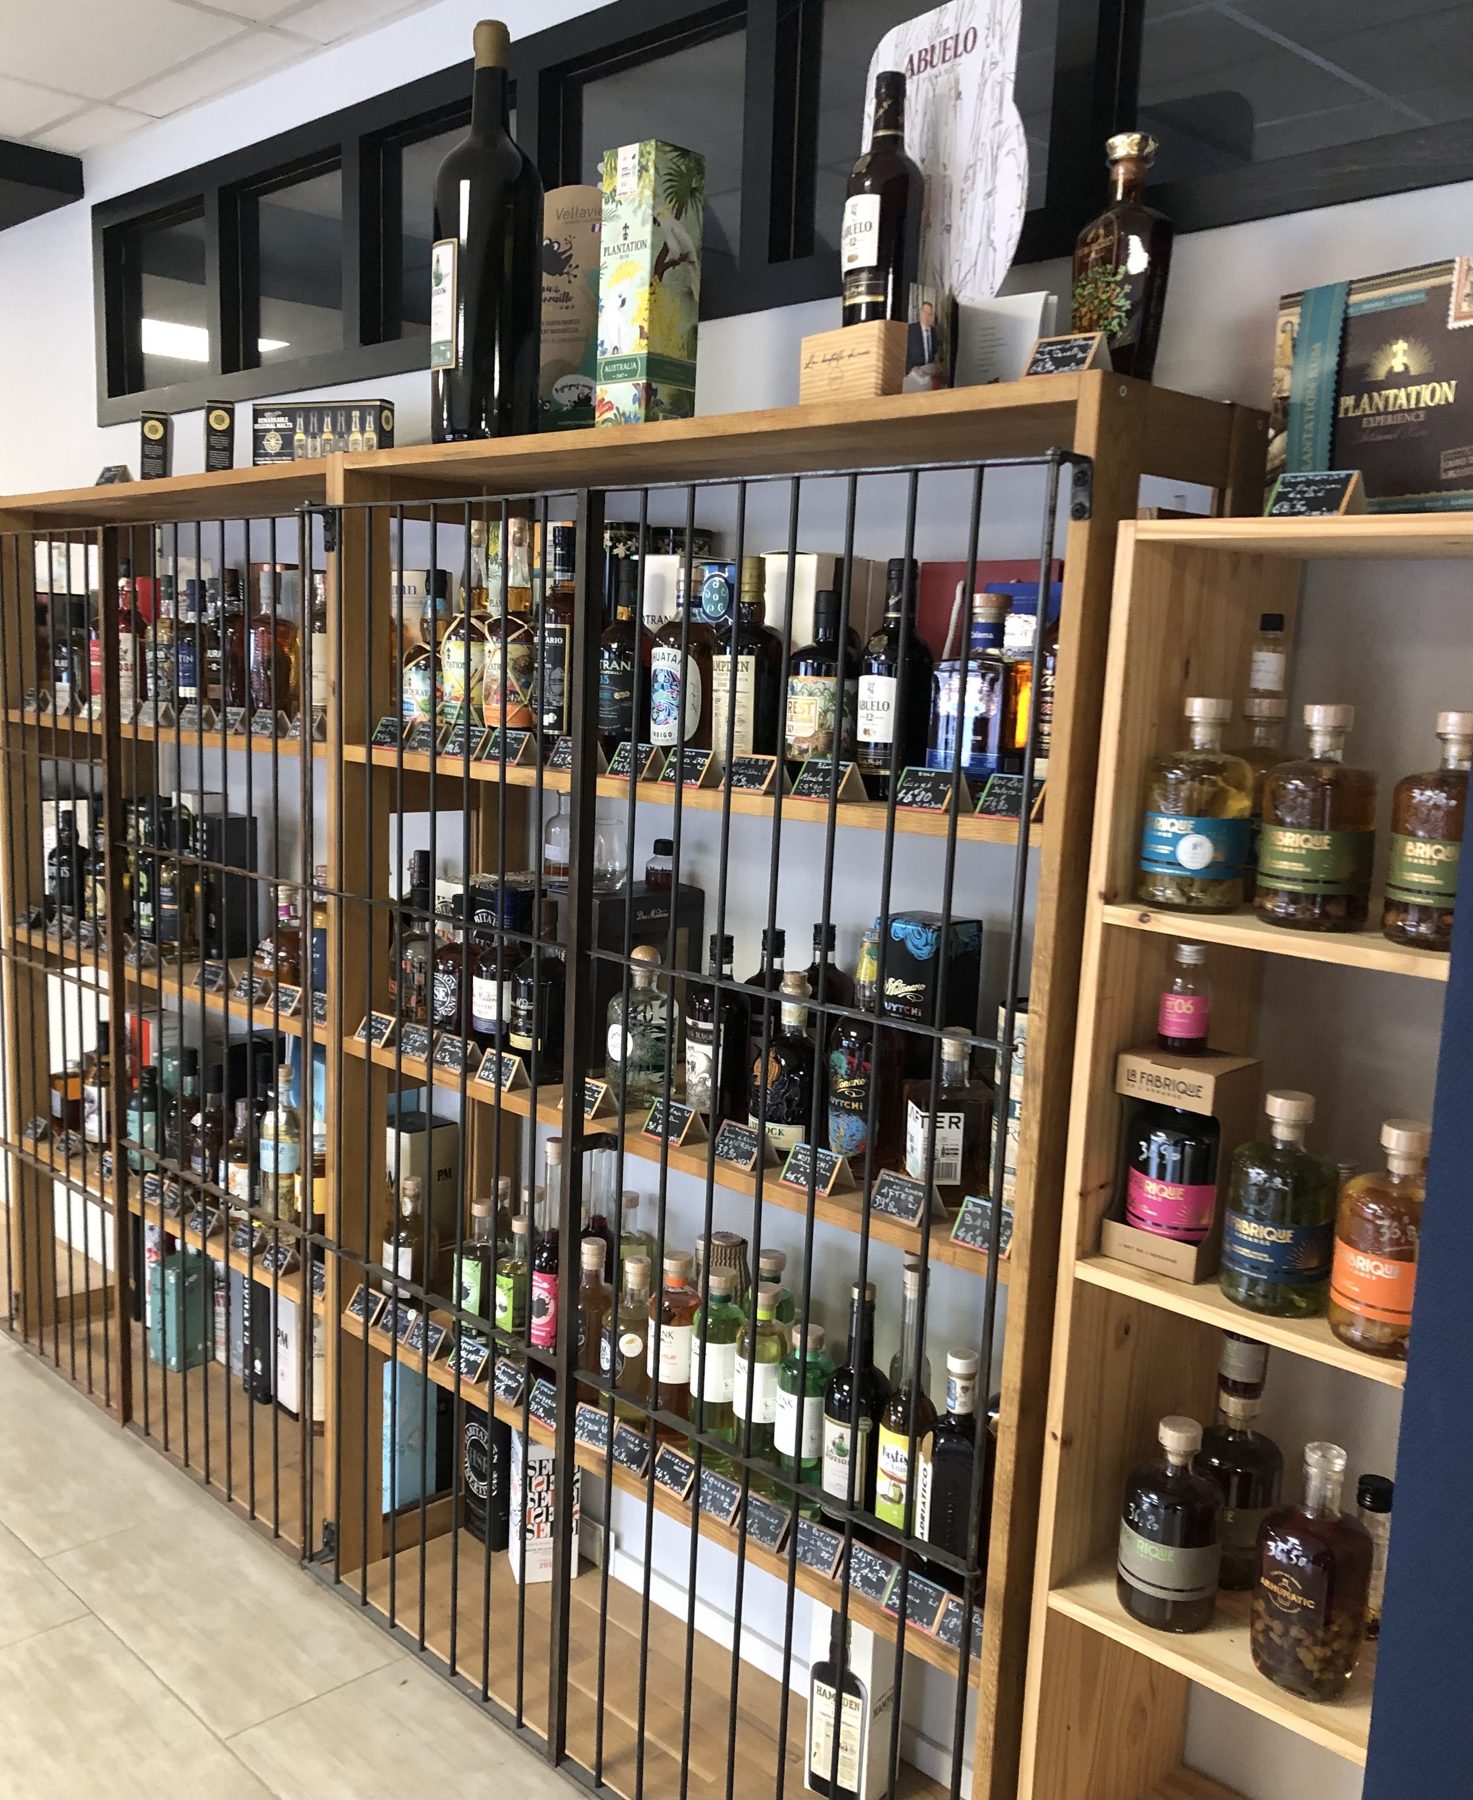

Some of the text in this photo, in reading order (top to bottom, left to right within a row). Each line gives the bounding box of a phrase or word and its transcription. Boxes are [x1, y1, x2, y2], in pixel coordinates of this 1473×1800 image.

[905, 26, 978, 78] ABUELO
[603, 239, 648, 257] PLANTATION
[604, 361, 637, 373] AUSTRALIA
[1338, 380, 1458, 418] PLANTATION
[1302, 381, 1320, 471] LANTATION
[1361, 410, 1426, 428] EXPERIENCE
[643, 614, 670, 625] TRAN
[600, 659, 631, 671] TRAN
[652, 652, 682, 666] HUATA
[713, 661, 750, 673] AMPEN
[787, 700, 814, 715] REST
[1153, 816, 1196, 834] RIQUE
[1272, 831, 1333, 851] BRIQUE
[1404, 841, 1459, 861] BRIQU
[433, 988, 448, 1002] SE
[1138, 1071, 1204, 1100] FABRIQUE
[1144, 1179, 1185, 1201] RIQUE
[920, 1466, 929, 1541] ADRIATICO
[1136, 1539, 1175, 1562] RIQUE
[815, 1684, 861, 1713] HAMDEN
